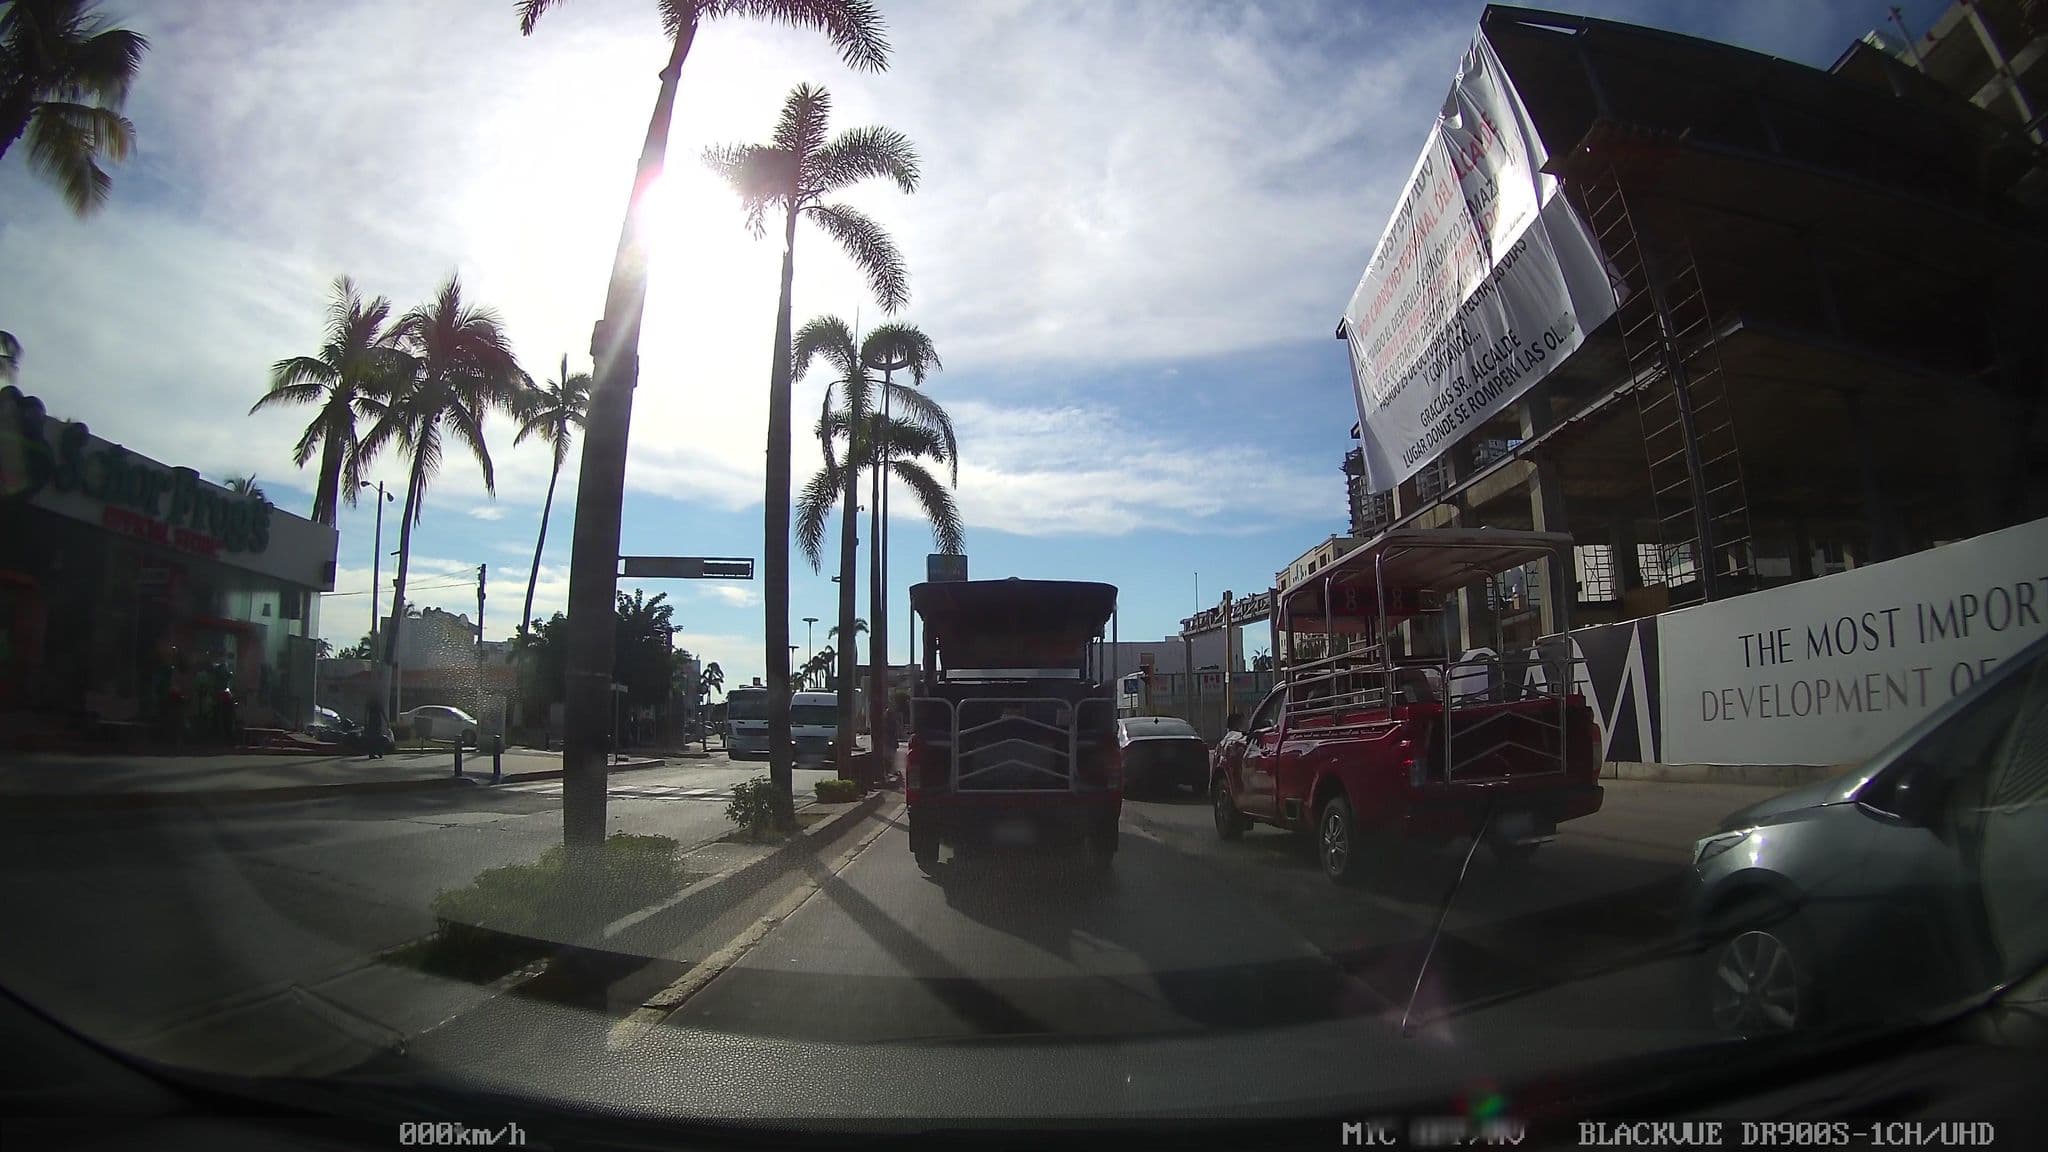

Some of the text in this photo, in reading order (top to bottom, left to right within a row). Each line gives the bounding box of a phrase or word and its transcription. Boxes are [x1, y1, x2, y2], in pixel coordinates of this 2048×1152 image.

[1433, 172, 1453, 217] DEL
[1458, 203, 1471, 231] DE
[1402, 434, 1428, 470] LUGAR
[1425, 410, 1456, 449] DONDE
[1455, 398, 1470, 425] SE
[1467, 357, 1520, 415] ROMPEN
[1517, 337, 1545, 376] LAS
[1419, 323, 1522, 429] GRACIAS SR. ALCALDE
[1422, 368, 1430, 388] Y
[1738, 627, 1795, 668] THE
[1807, 608, 1900, 660] MOST
[1702, 667, 1932, 723] DEVELOPMENT
